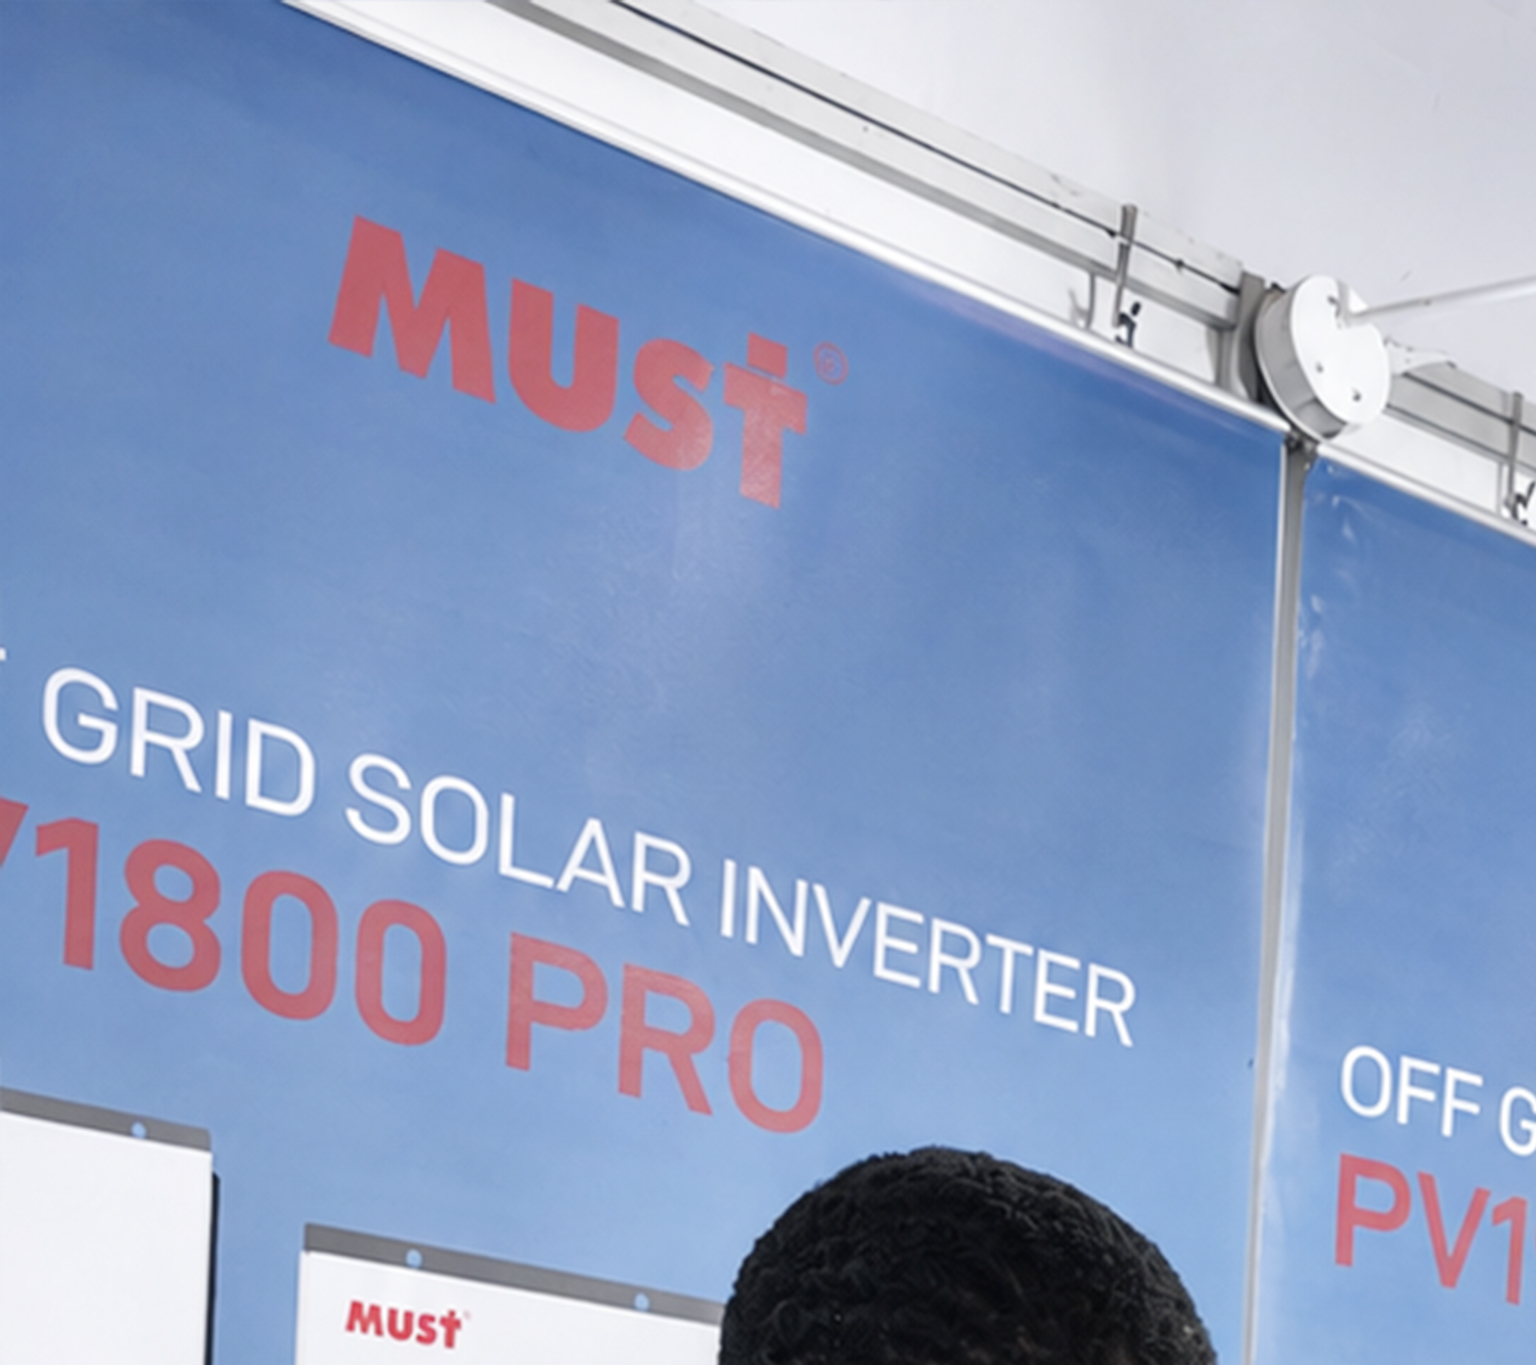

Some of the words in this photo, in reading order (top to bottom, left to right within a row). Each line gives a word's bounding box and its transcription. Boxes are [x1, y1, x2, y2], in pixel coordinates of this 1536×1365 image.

[42, 668, 315, 816] GRID
[345, 753, 691, 926] SOLAR
[720, 858, 1136, 1048] INVERTER
[505, 932, 824, 1134] PRO
[1339, 1046, 1484, 1138] OFF
